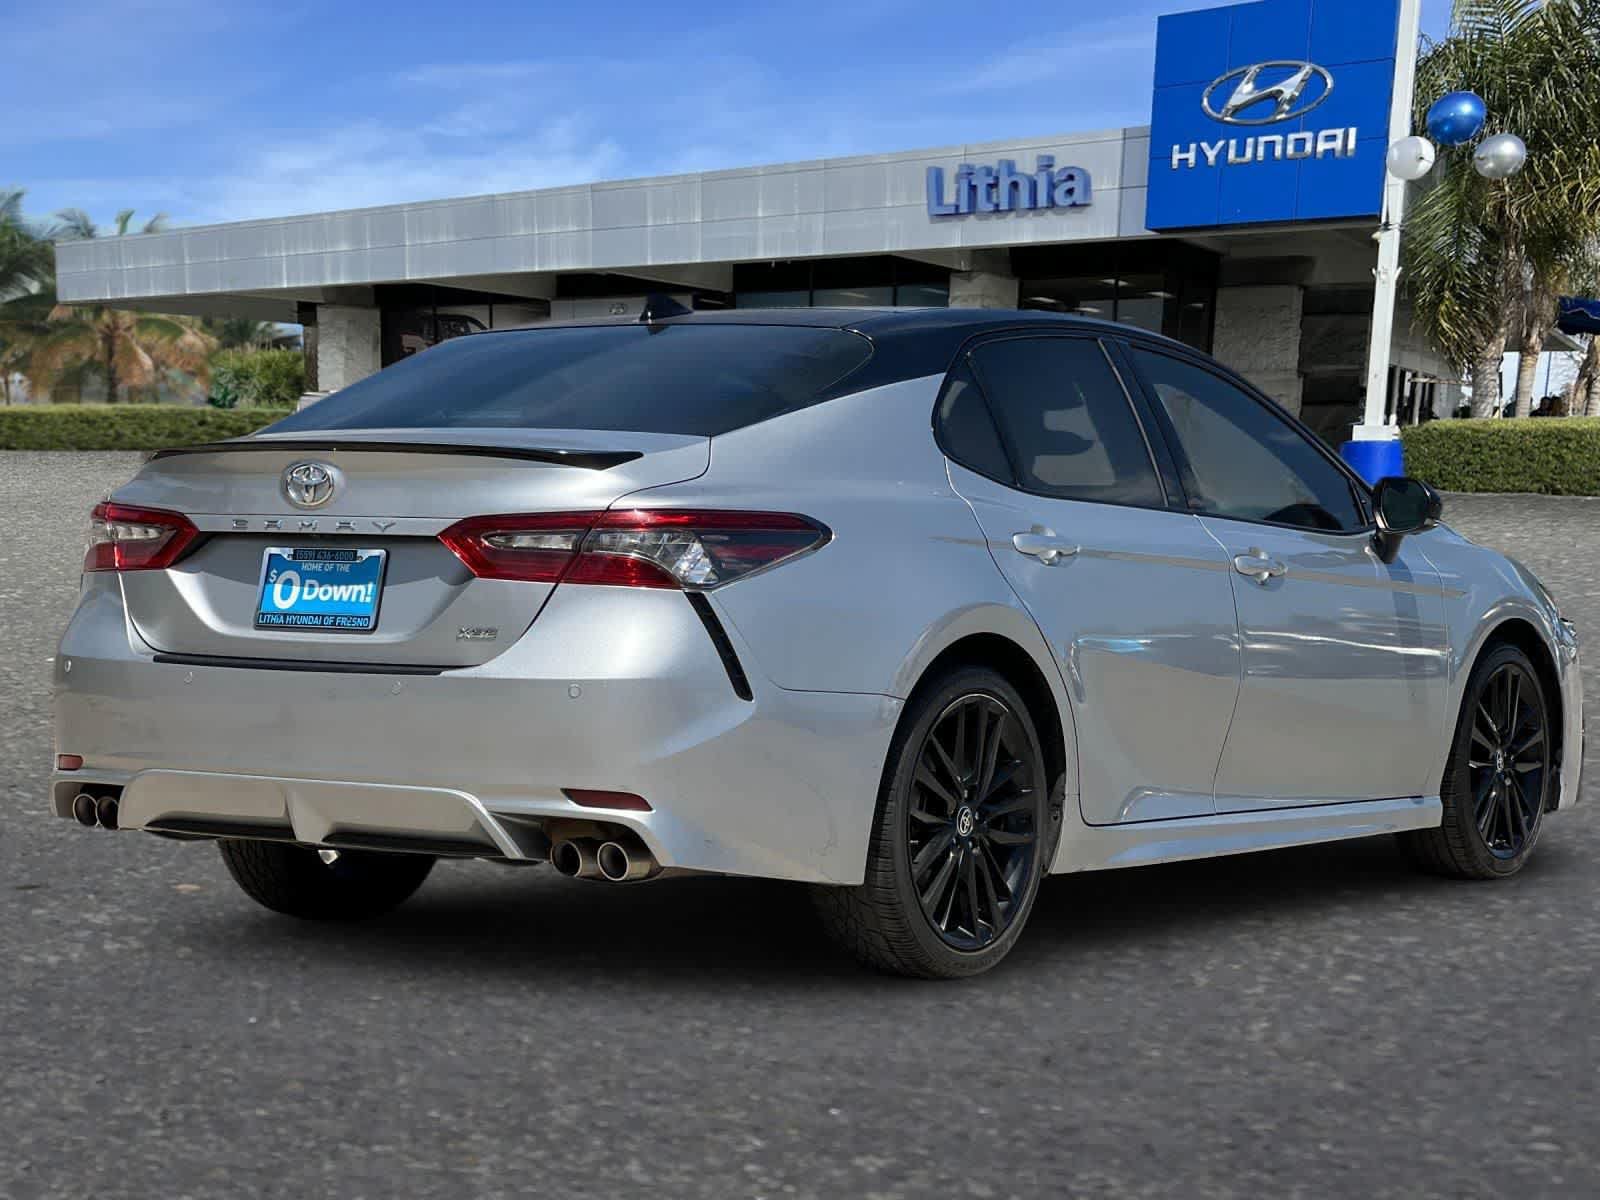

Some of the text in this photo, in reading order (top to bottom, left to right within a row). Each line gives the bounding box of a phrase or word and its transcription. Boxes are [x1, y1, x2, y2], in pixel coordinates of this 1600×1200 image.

[1171, 127, 1358, 169] HYUNDAI
[926, 154, 1092, 220] Lithia
[232, 519, 397, 533] CAMRY
[295, 550, 316, 560] (559)
[301, 562, 352, 573] HOME OF THE
[302, 580, 373, 603] Down!
[259, 614, 370, 627] LITHIA HYUNDAI OF FRESNO
